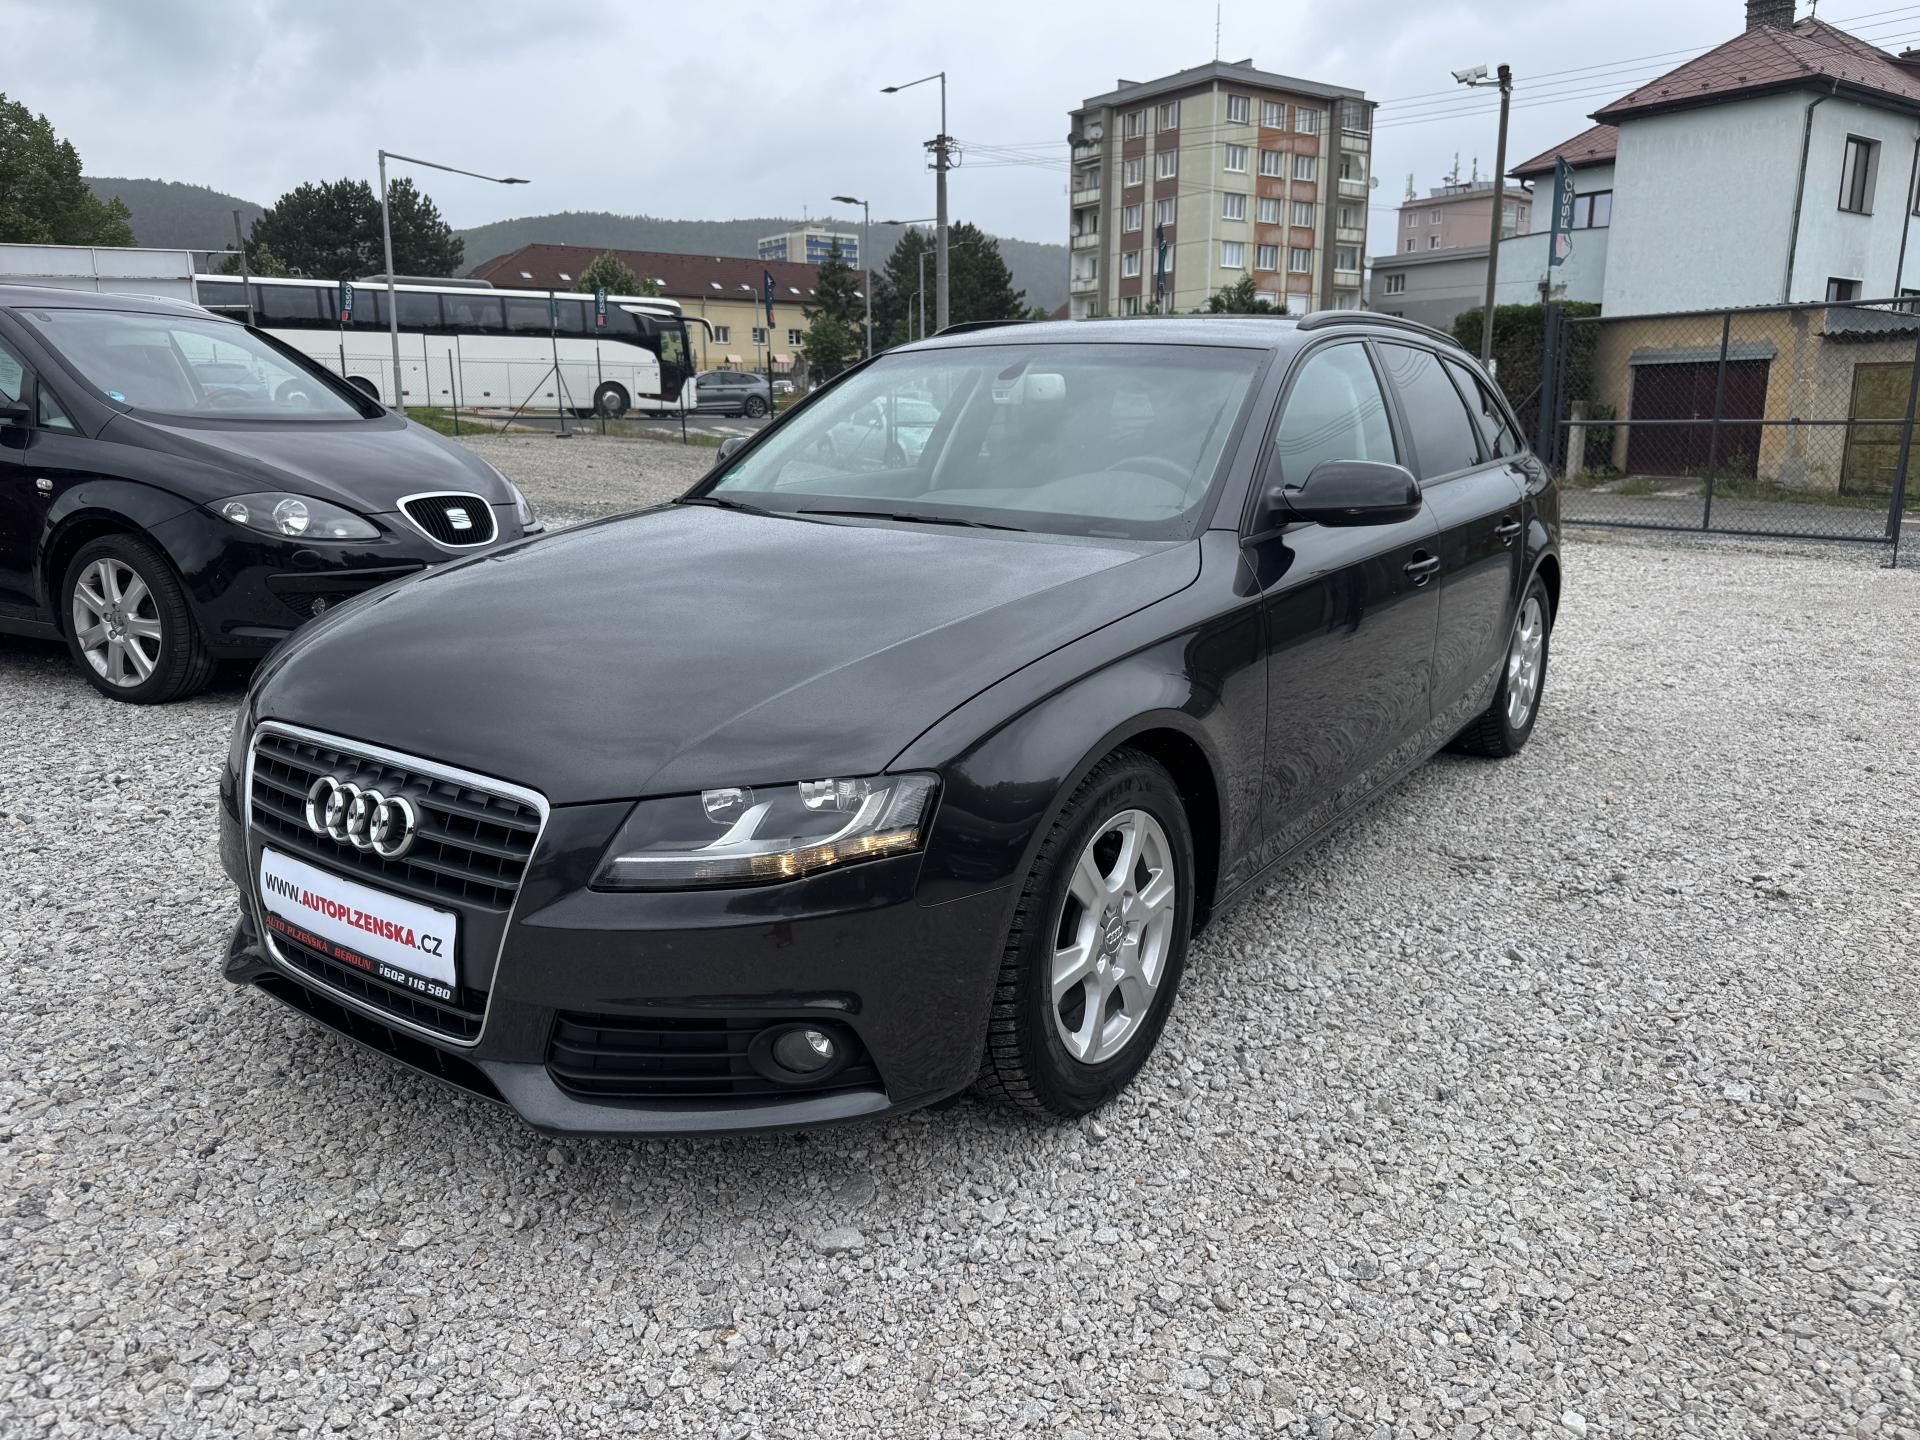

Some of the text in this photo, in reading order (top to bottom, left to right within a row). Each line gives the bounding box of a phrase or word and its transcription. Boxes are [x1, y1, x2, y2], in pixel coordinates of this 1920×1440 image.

[265, 872, 442, 957] WWW.AUTOPLZENSKA.CZ
[266, 916, 285, 931] AUTO
[335, 948, 371, 970] BEROUN
[384, 968, 405, 984] 602
[408, 977, 425, 991] 116
[427, 984, 450, 1000] 580
